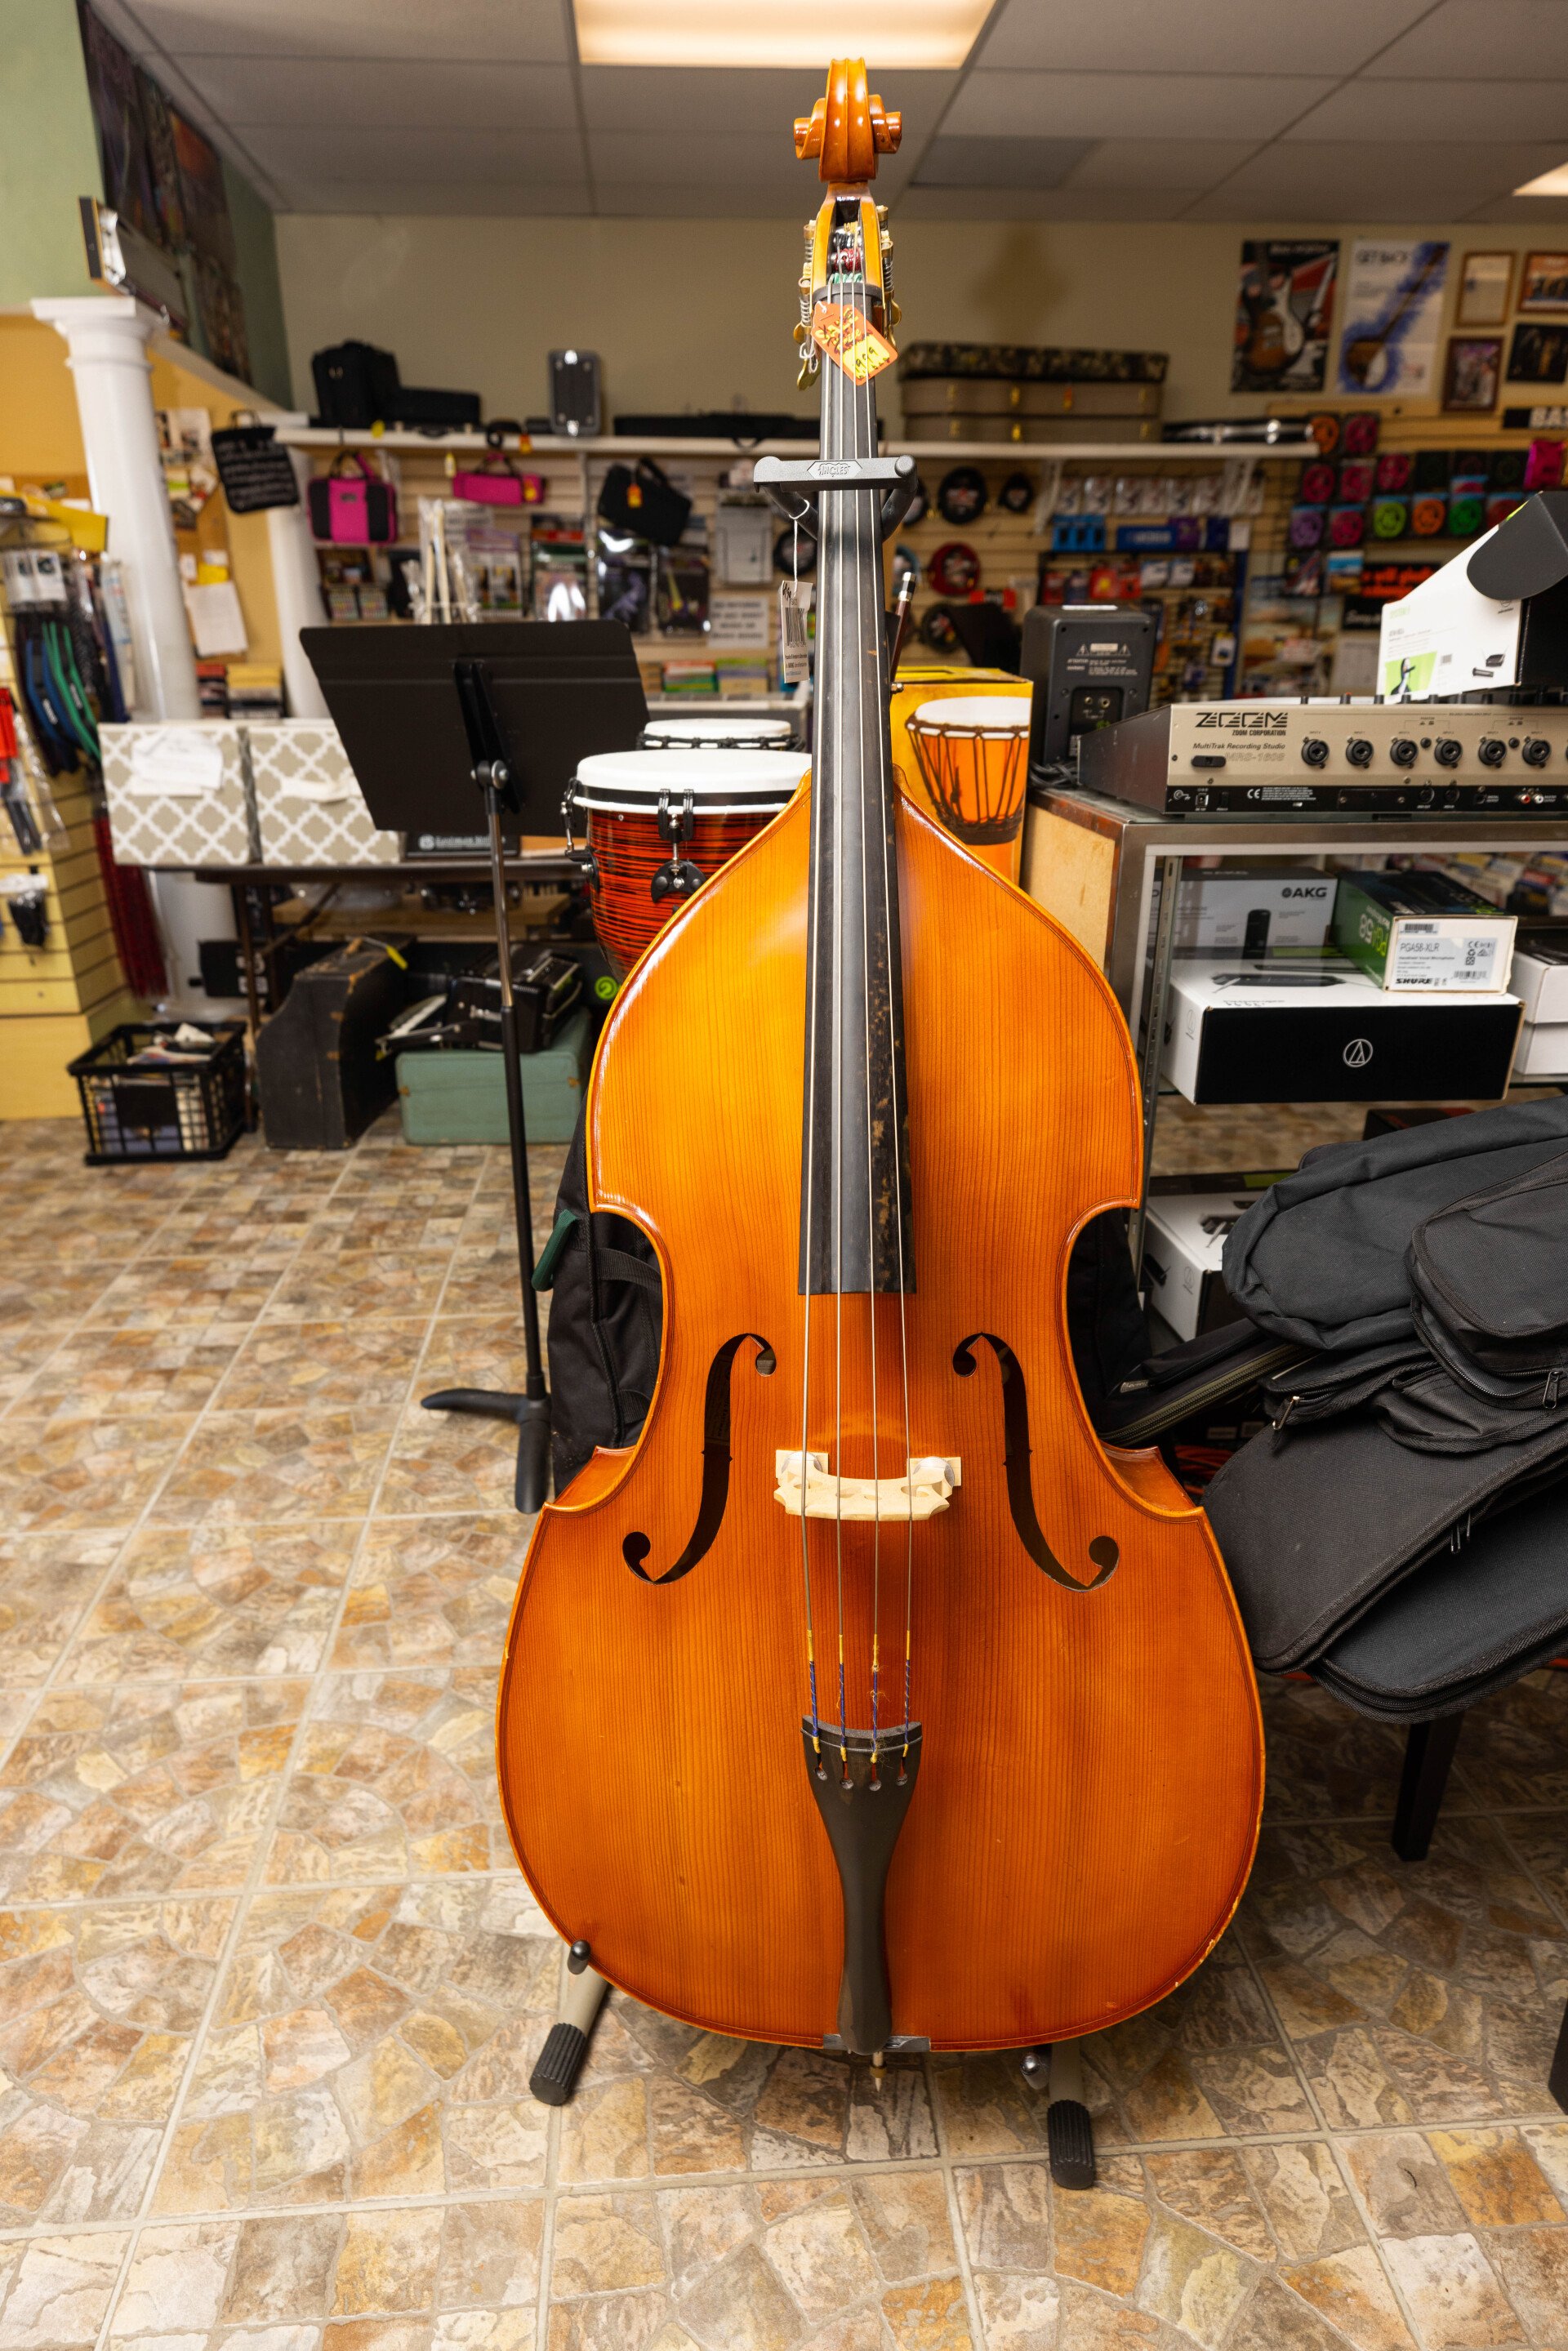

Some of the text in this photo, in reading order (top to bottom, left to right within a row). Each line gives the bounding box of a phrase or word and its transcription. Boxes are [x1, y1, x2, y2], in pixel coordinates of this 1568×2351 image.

[1195, 712, 1288, 728] ZOOM
[1227, 742, 1262, 750] Recording
[1292, 887, 1327, 898] AKG
[1400, 942, 1441, 953] PGA58-XLR
